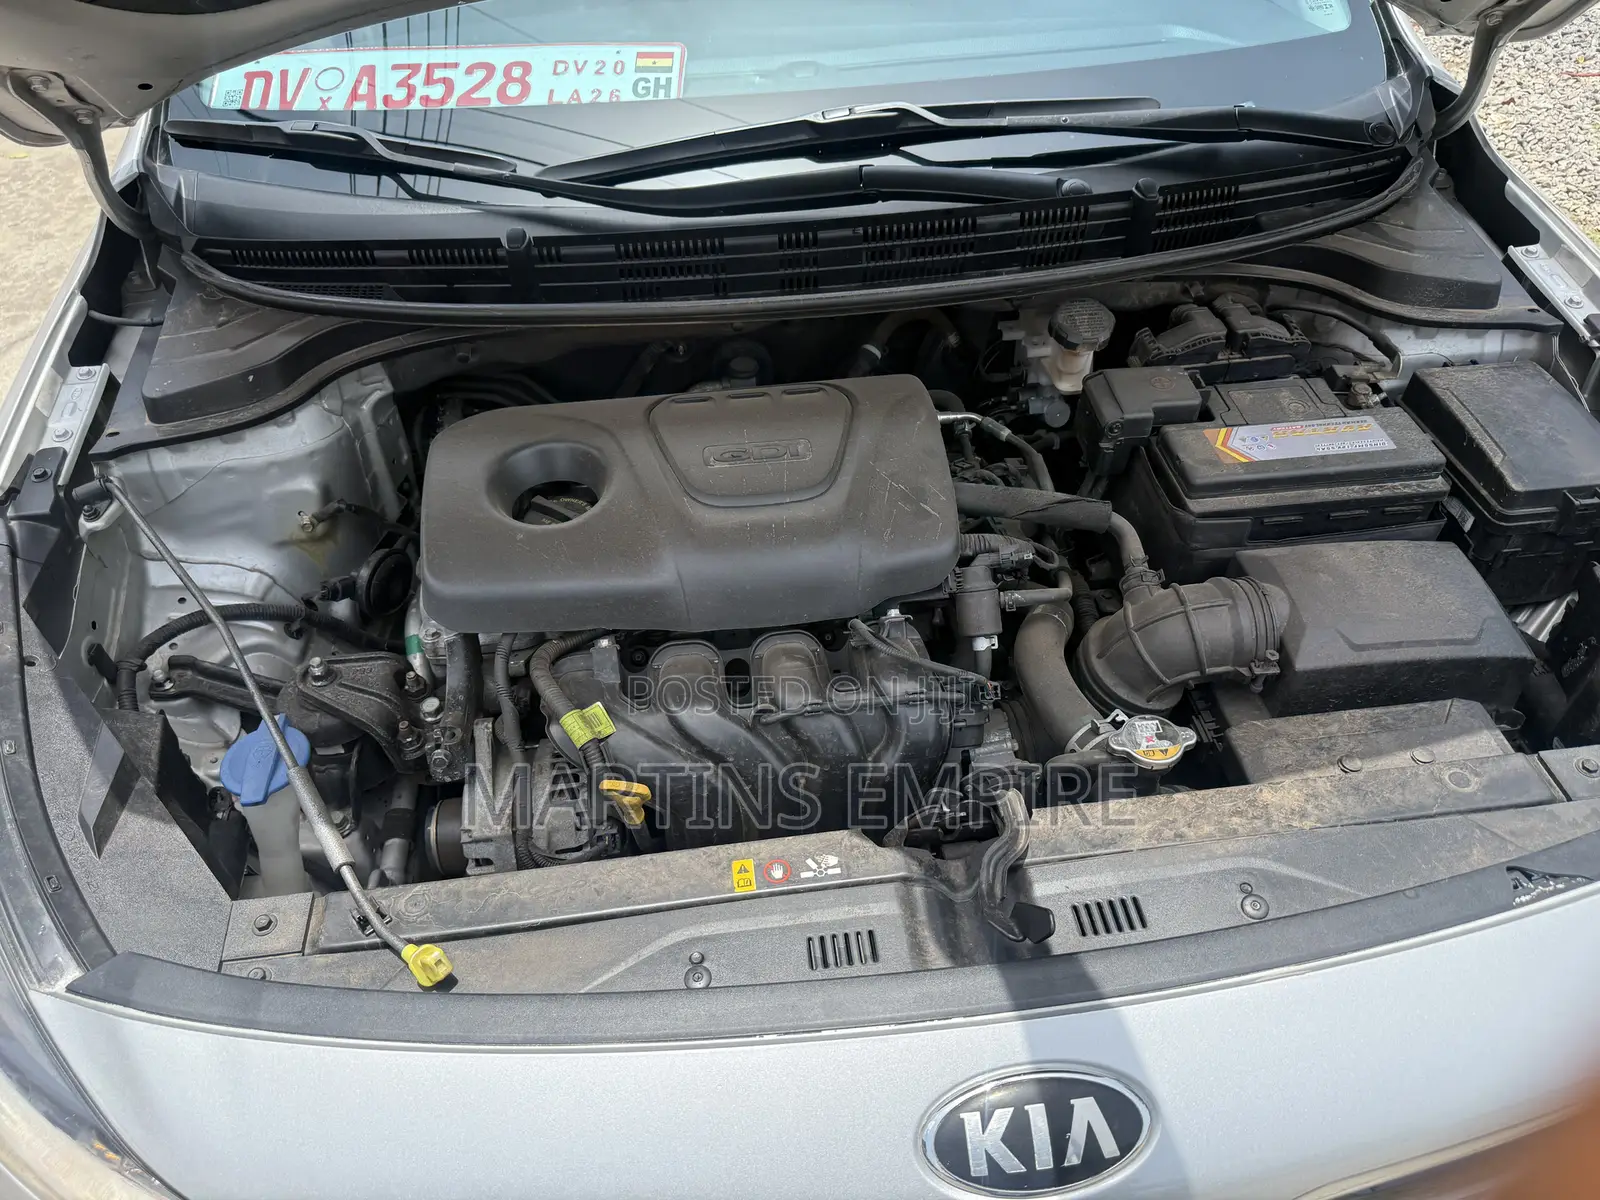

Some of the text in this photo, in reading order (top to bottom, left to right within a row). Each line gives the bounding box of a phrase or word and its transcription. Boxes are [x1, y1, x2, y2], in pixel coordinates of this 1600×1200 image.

[553, 59, 625, 76] DV20
[240, 67, 312, 110] DV
[344, 61, 532, 110] A3528
[632, 77, 672, 99] GH
[710, 442, 801, 464] GDI
[960, 1096, 1120, 1177] KIA
